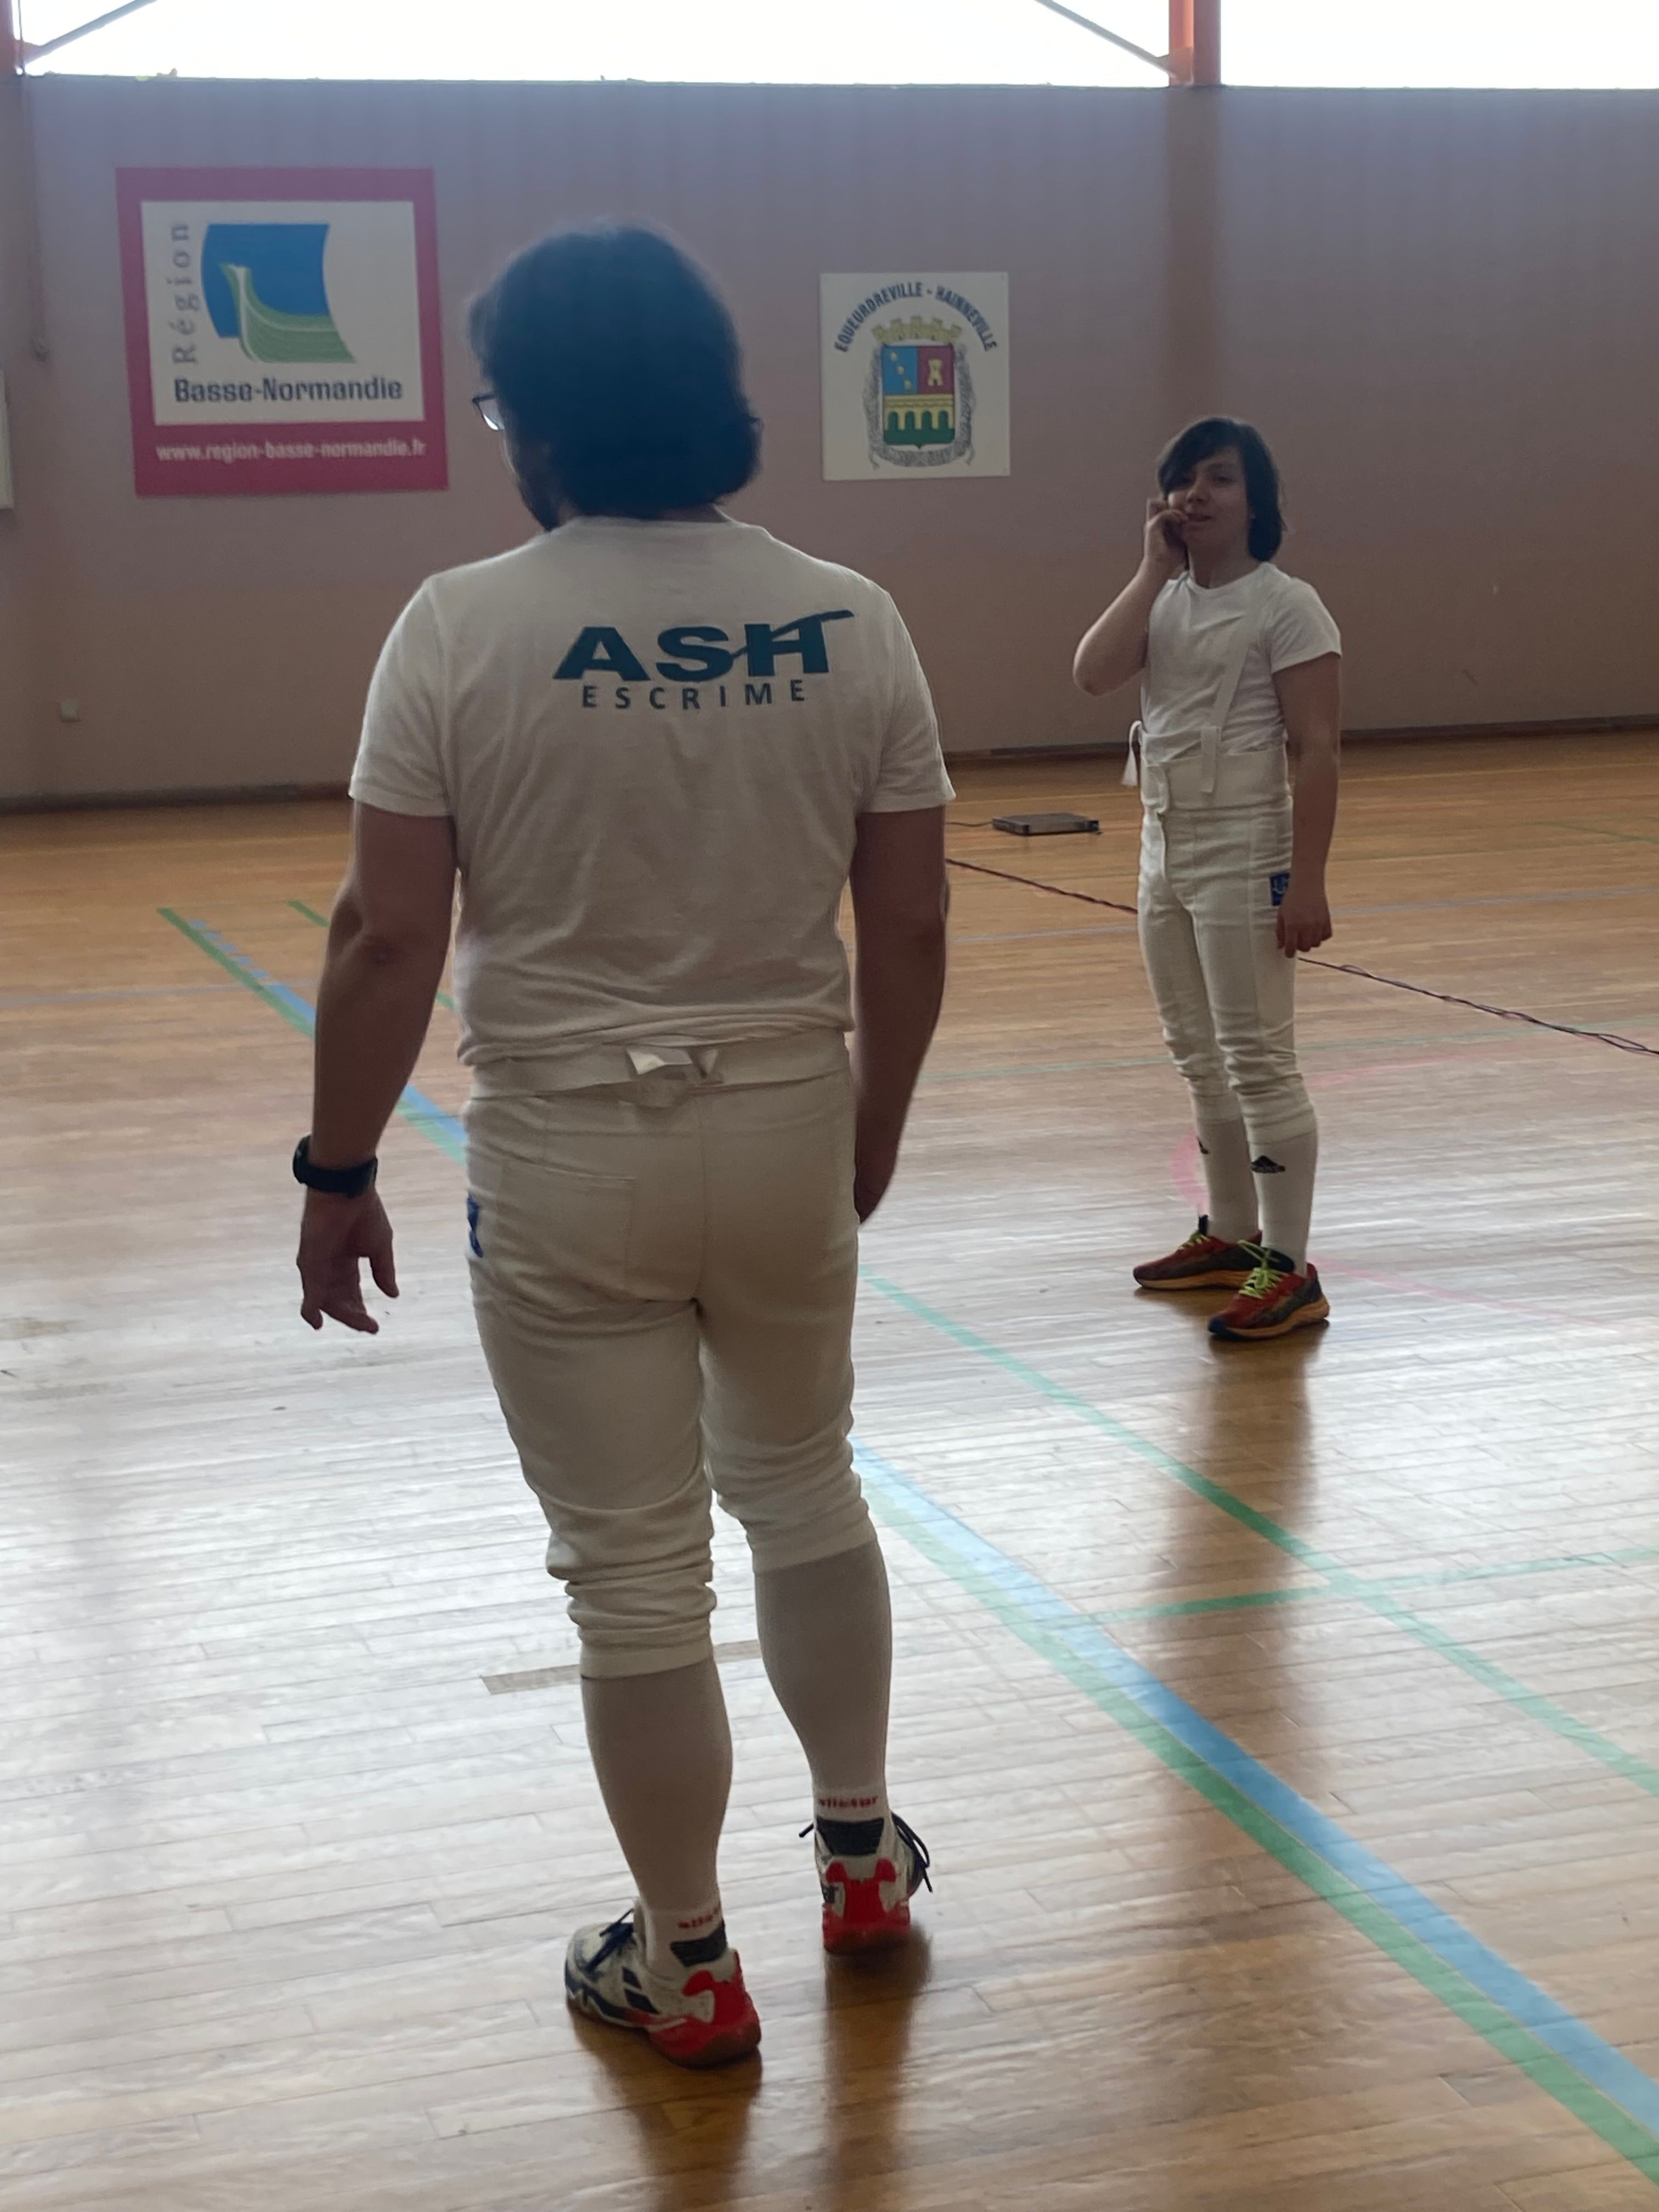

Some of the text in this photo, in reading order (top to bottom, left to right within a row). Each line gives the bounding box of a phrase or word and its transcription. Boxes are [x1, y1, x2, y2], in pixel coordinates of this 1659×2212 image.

[167, 222, 201, 365] Région
[174, 376, 403, 403] Basse-Normandie
[156, 438, 426, 462] www.region-basse-normandie.fr
[552, 610, 854, 682] ASH
[582, 679, 805, 709] ESCRIME
